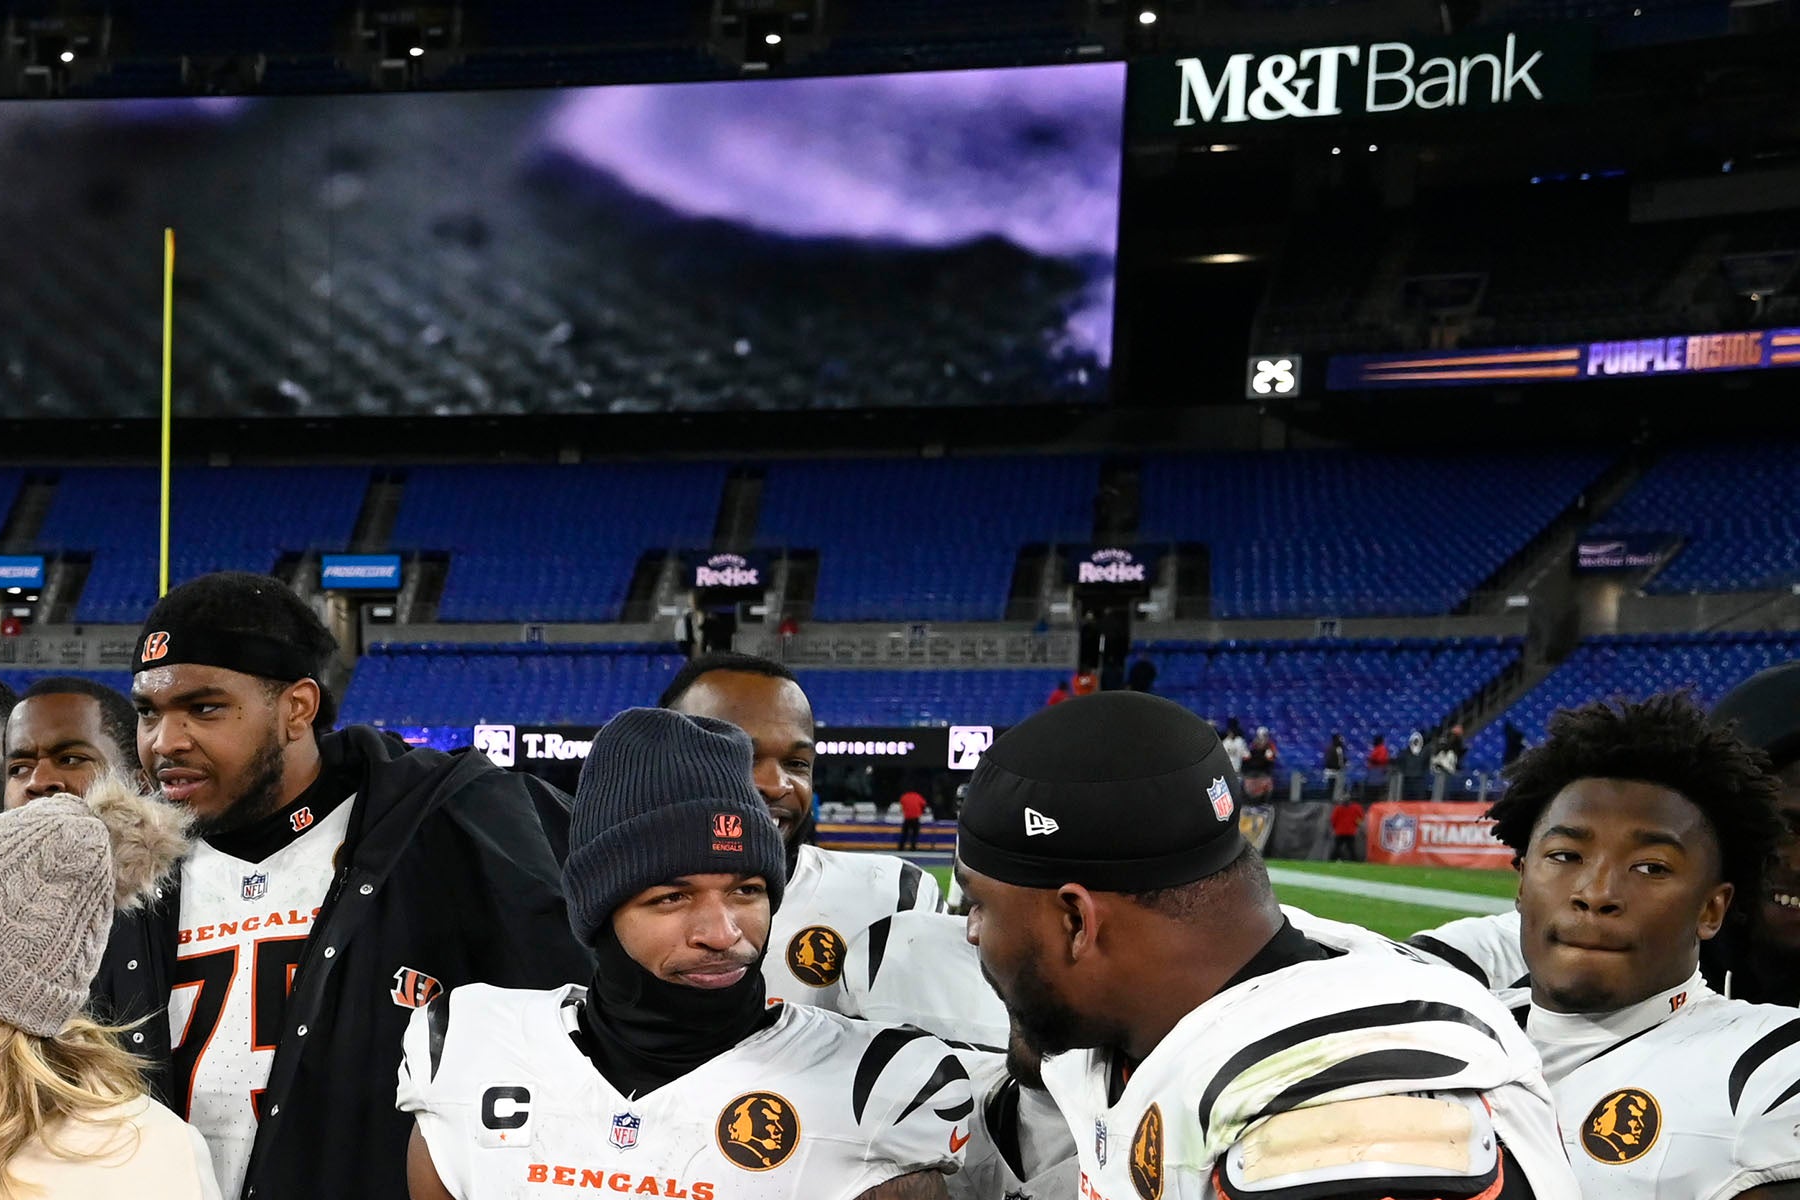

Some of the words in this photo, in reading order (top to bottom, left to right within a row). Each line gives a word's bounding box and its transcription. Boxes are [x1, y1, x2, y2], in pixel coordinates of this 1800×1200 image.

[1173, 45, 1360, 126] M&T
[1365, 32, 1544, 113] Bank
[1586, 335, 1685, 376] PURPLE
[1685, 331, 1764, 371] RISING
[1251, 358, 1296, 395] 25
[522, 733, 593, 760] T.Row
[481, 1086, 532, 1133] C
